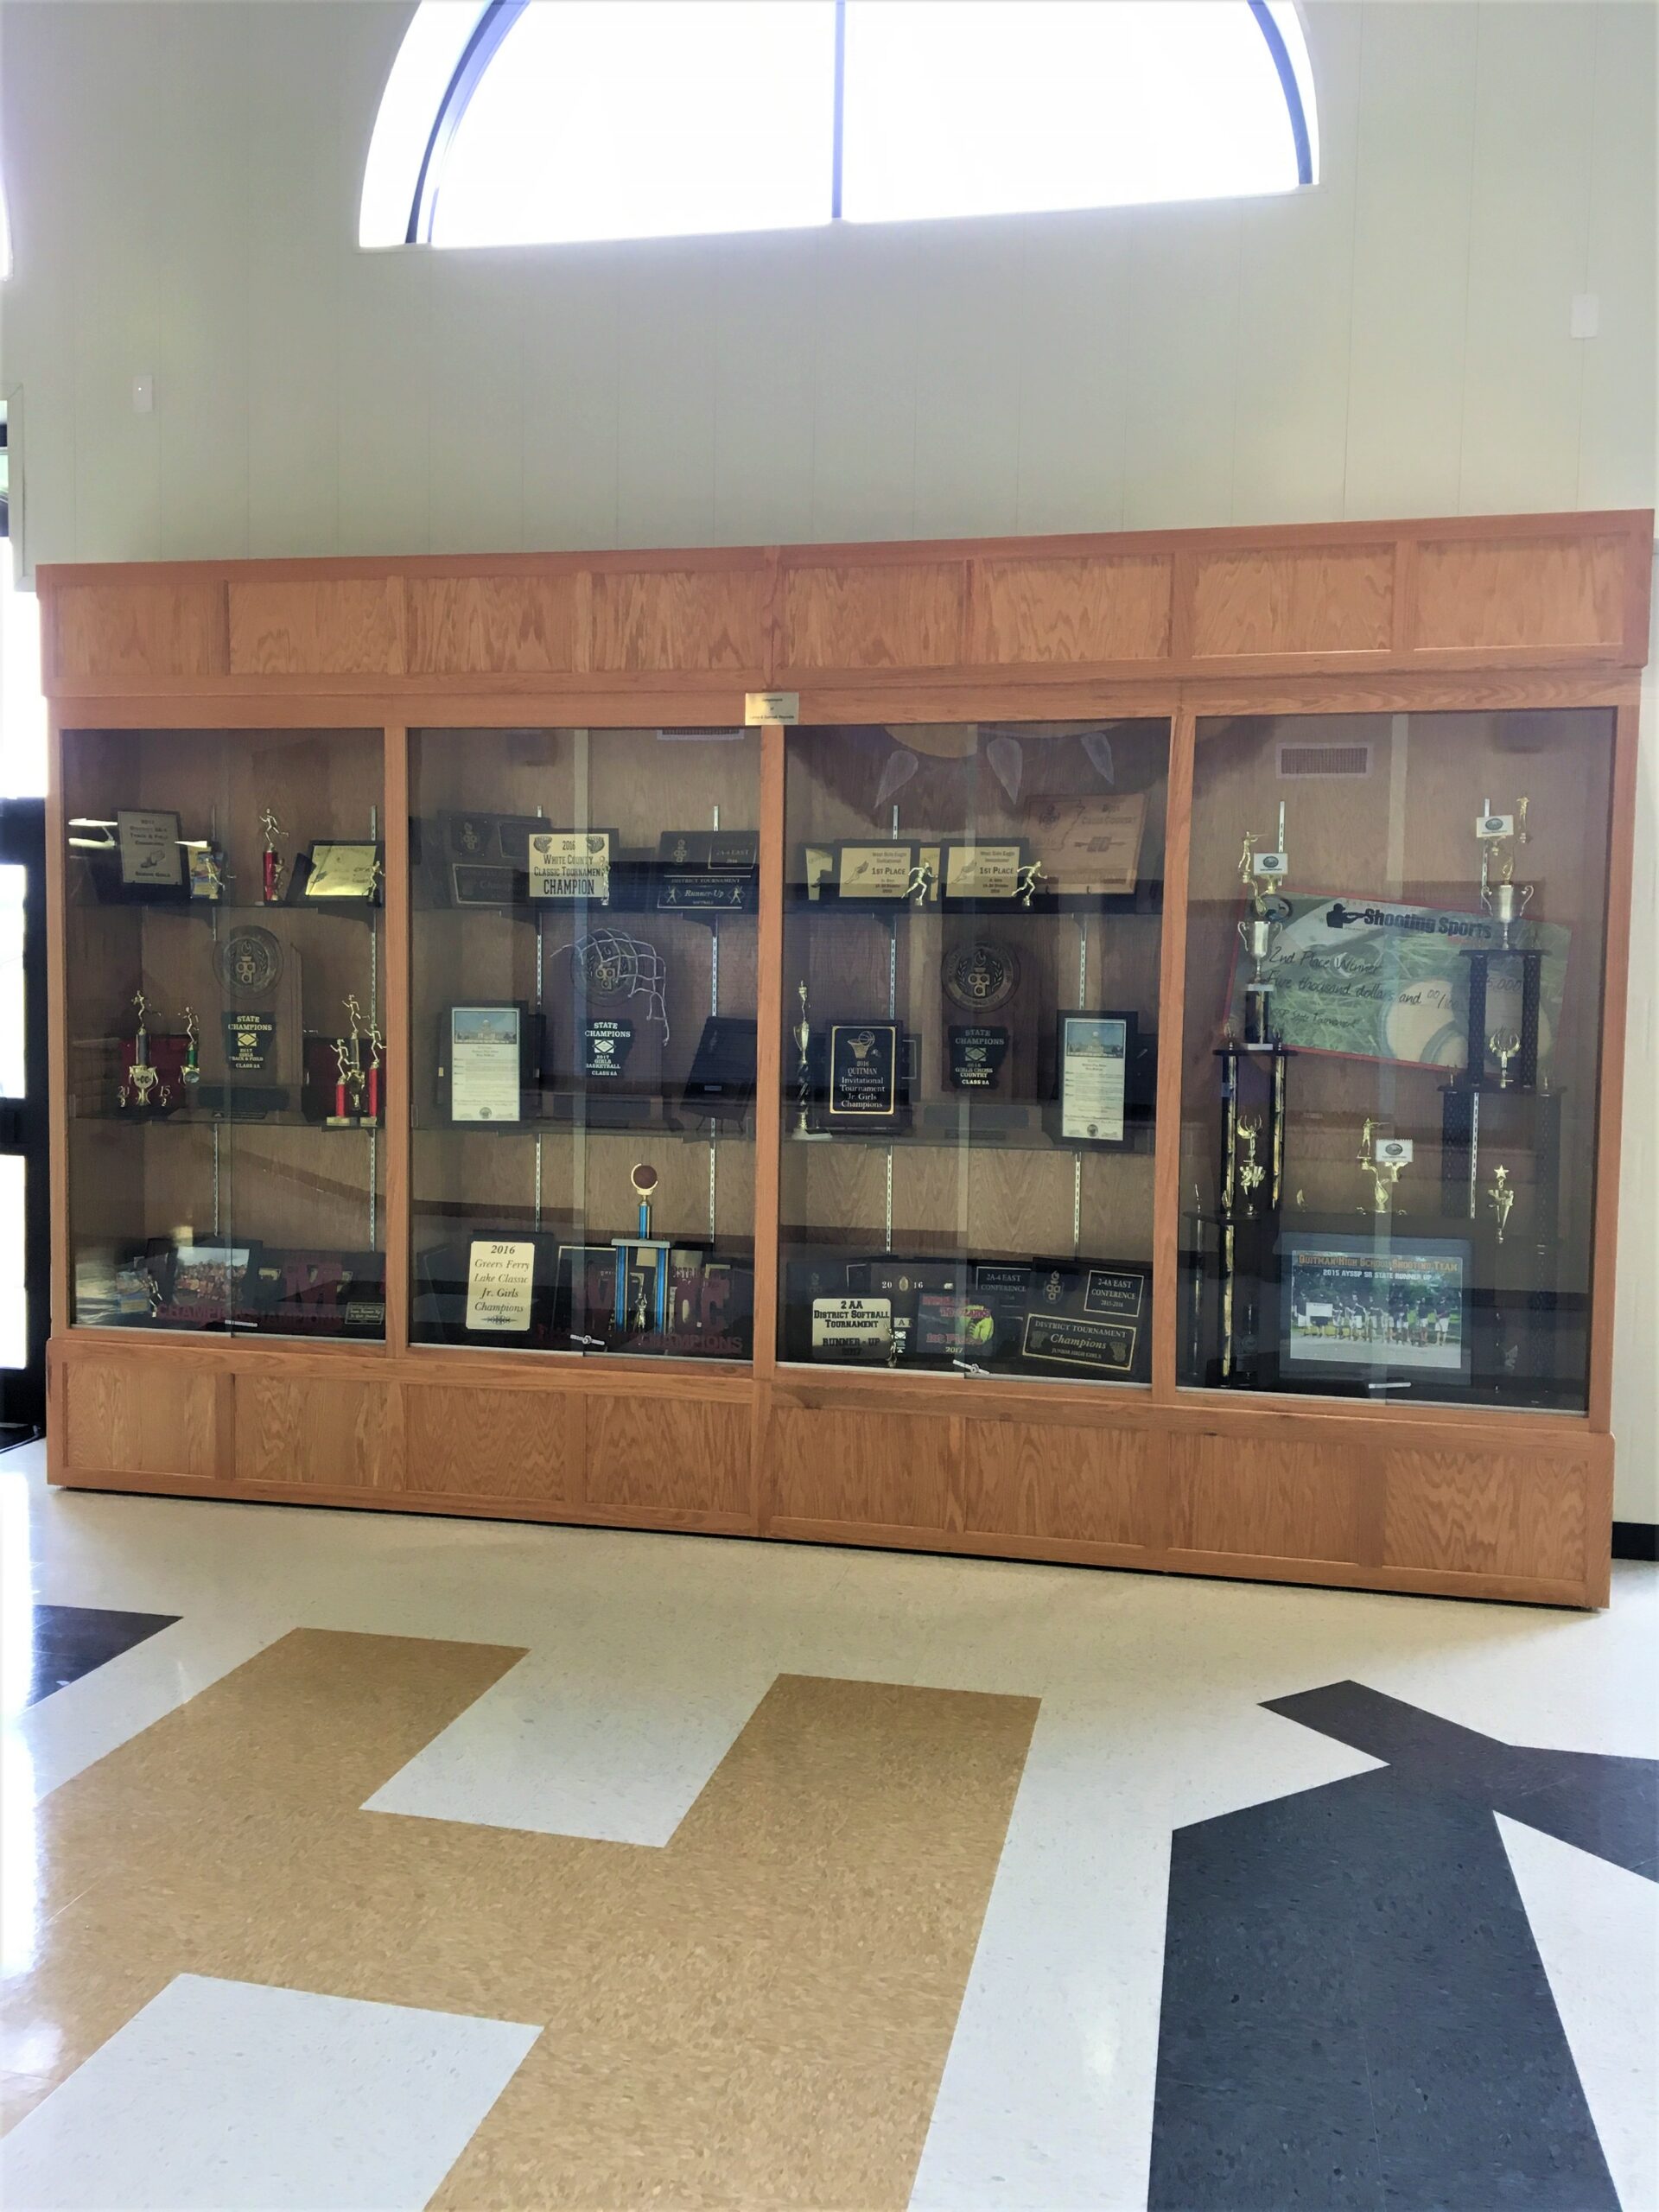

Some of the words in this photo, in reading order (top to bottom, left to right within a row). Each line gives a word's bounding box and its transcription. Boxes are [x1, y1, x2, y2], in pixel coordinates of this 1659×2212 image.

[543, 879, 595, 895] CHAMPION
[1363, 908, 1436, 934] Shooting
[1438, 916, 1492, 939] Sports
[1398, 992, 1422, 1006] and
[848, 1067, 877, 1077] QUITMAN
[841, 1100, 883, 1109] Champions
[491, 1244, 516, 1255] 2016
[506, 1260, 530, 1272] Ferry
[474, 1273, 496, 1282] Lake
[1113, 1280, 1133, 1288] EAST
[497, 1288, 518, 1298] Girls
[1091, 1288, 1136, 1300] CONFERENCE
[474, 1301, 524, 1314] Champions
[841, 1300, 847, 1309] 2
[849, 1300, 863, 1309] AA
[814, 1310, 849, 1319] DISTRICT
[851, 1310, 889, 1319] SOFTBALL
[825, 1319, 879, 1328] TOURNAMENT
[1035, 1320, 1071, 1332] DISTRICT
[1072, 1325, 1127, 1338] TOURNAMENT
[1050, 1333, 1107, 1349] Champions
